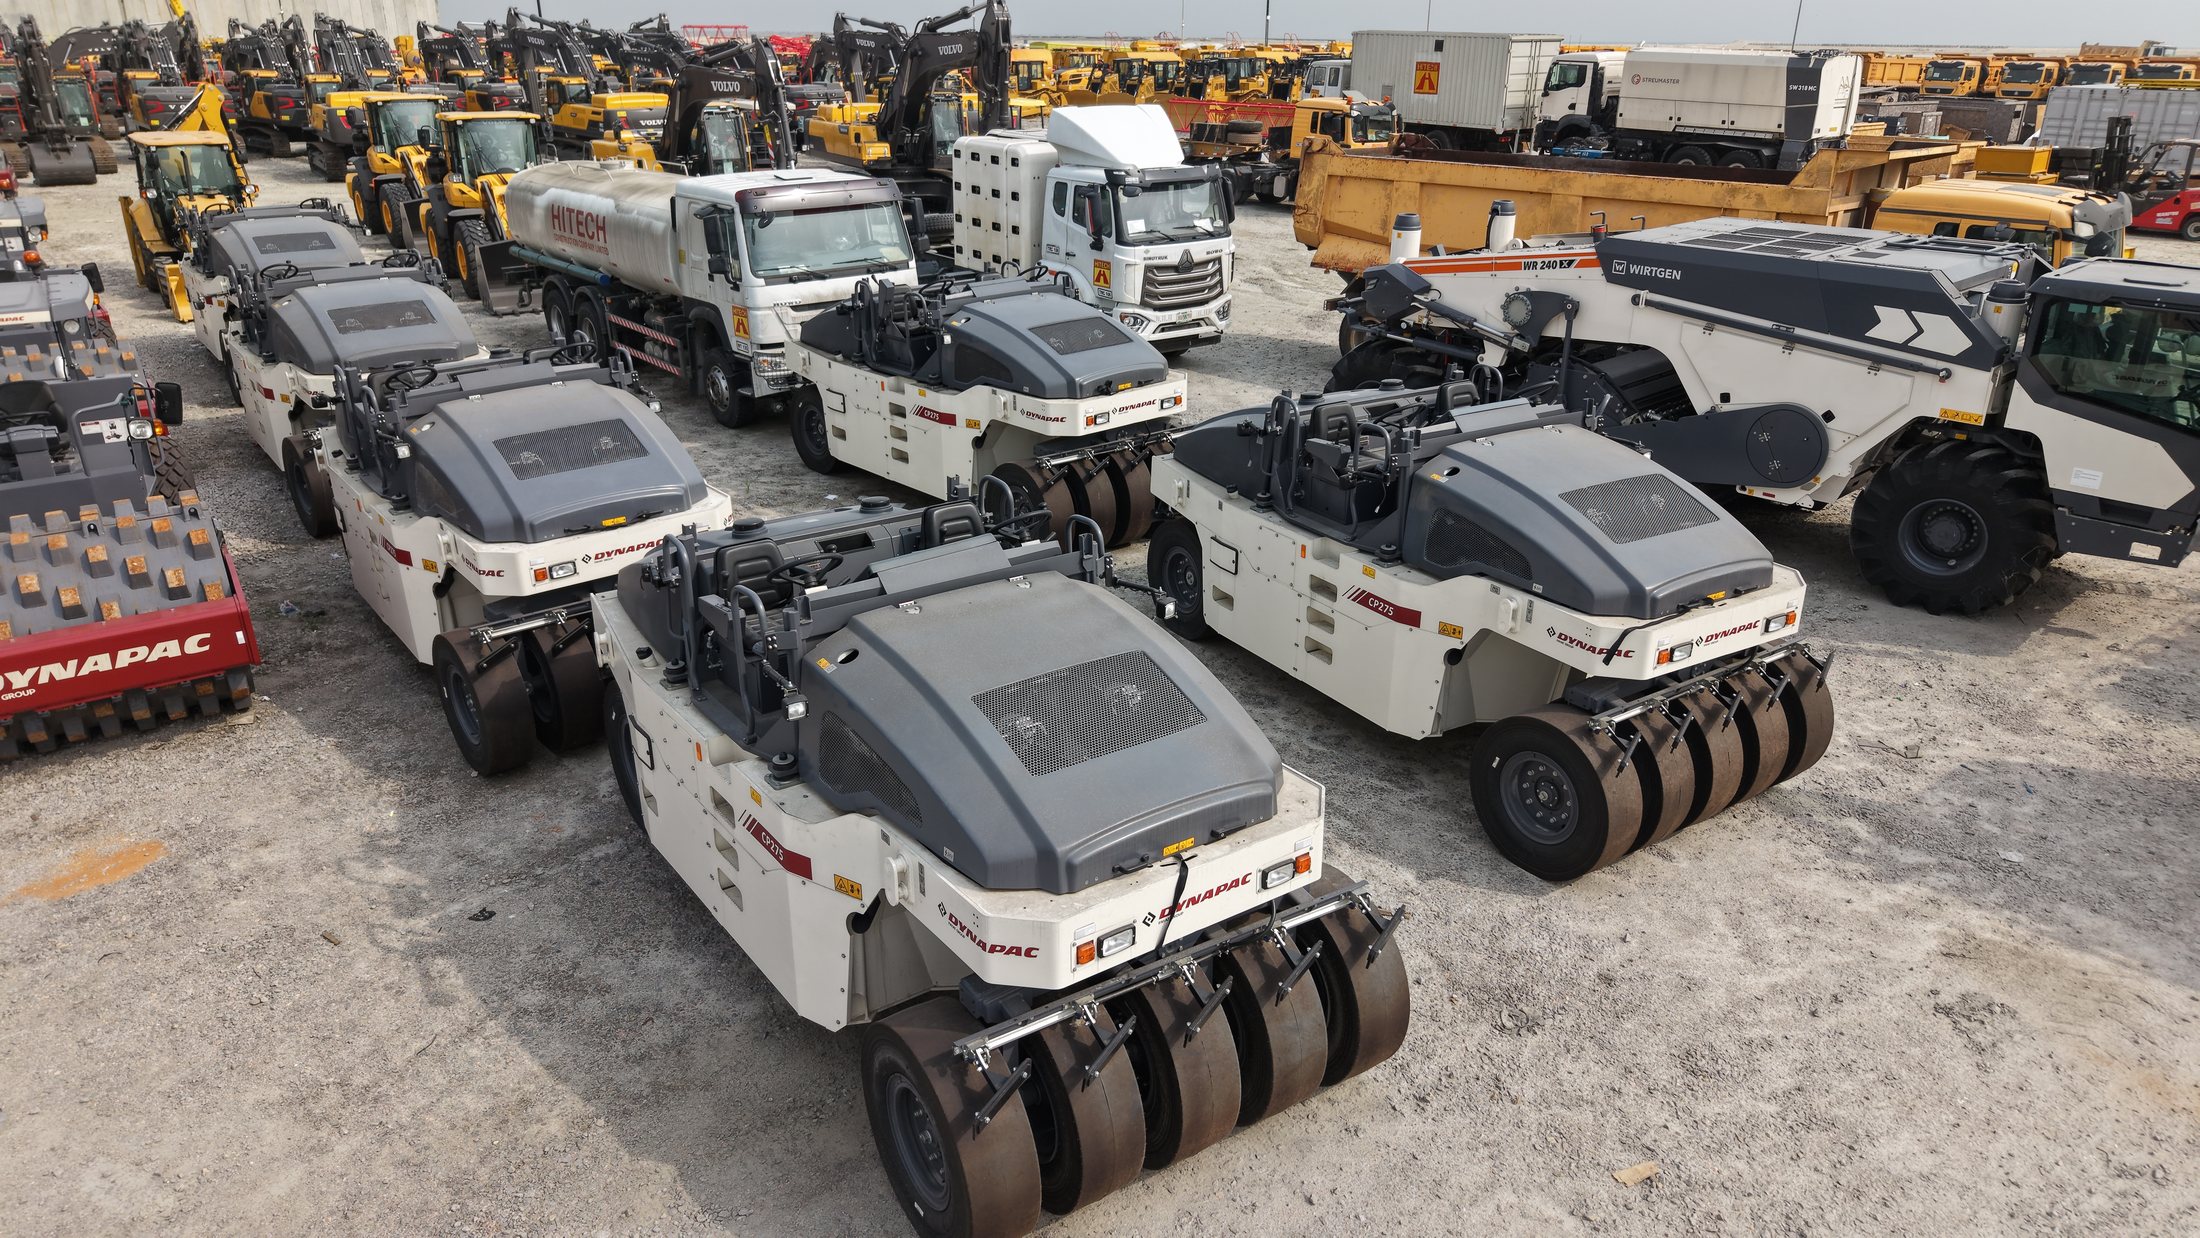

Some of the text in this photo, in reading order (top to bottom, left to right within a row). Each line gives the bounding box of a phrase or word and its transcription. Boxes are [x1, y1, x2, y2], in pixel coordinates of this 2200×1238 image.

[527, 36, 546, 47] VOLVO
[856, 38, 876, 49] VOLVO
[938, 43, 963, 56] VOLVO
[710, 80, 741, 93] VOLVO
[1642, 77, 1680, 85] STREUMASTER
[551, 203, 608, 244] HITECH
[1523, 260, 1538, 271] WR
[1539, 259, 1558, 270] 240
[1629, 264, 1682, 281] WIRTGEN
[1118, 399, 1157, 413] DYNAPAC
[923, 409, 940, 421] CP275
[1025, 410, 1067, 423] DYNAPAC
[594, 538, 664, 560] DYNAPAC
[465, 557, 504, 577] DYNAPAC
[1368, 597, 1394, 616] CP275
[1704, 619, 1760, 643] DYNAPAC
[0, 632, 211, 692] YNAPAC
[1, 688, 36, 701] GROUP
[761, 831, 784, 861] CP275
[1158, 872, 1252, 920] DYNAPAC
[947, 912, 1040, 958] DYNAPAC
